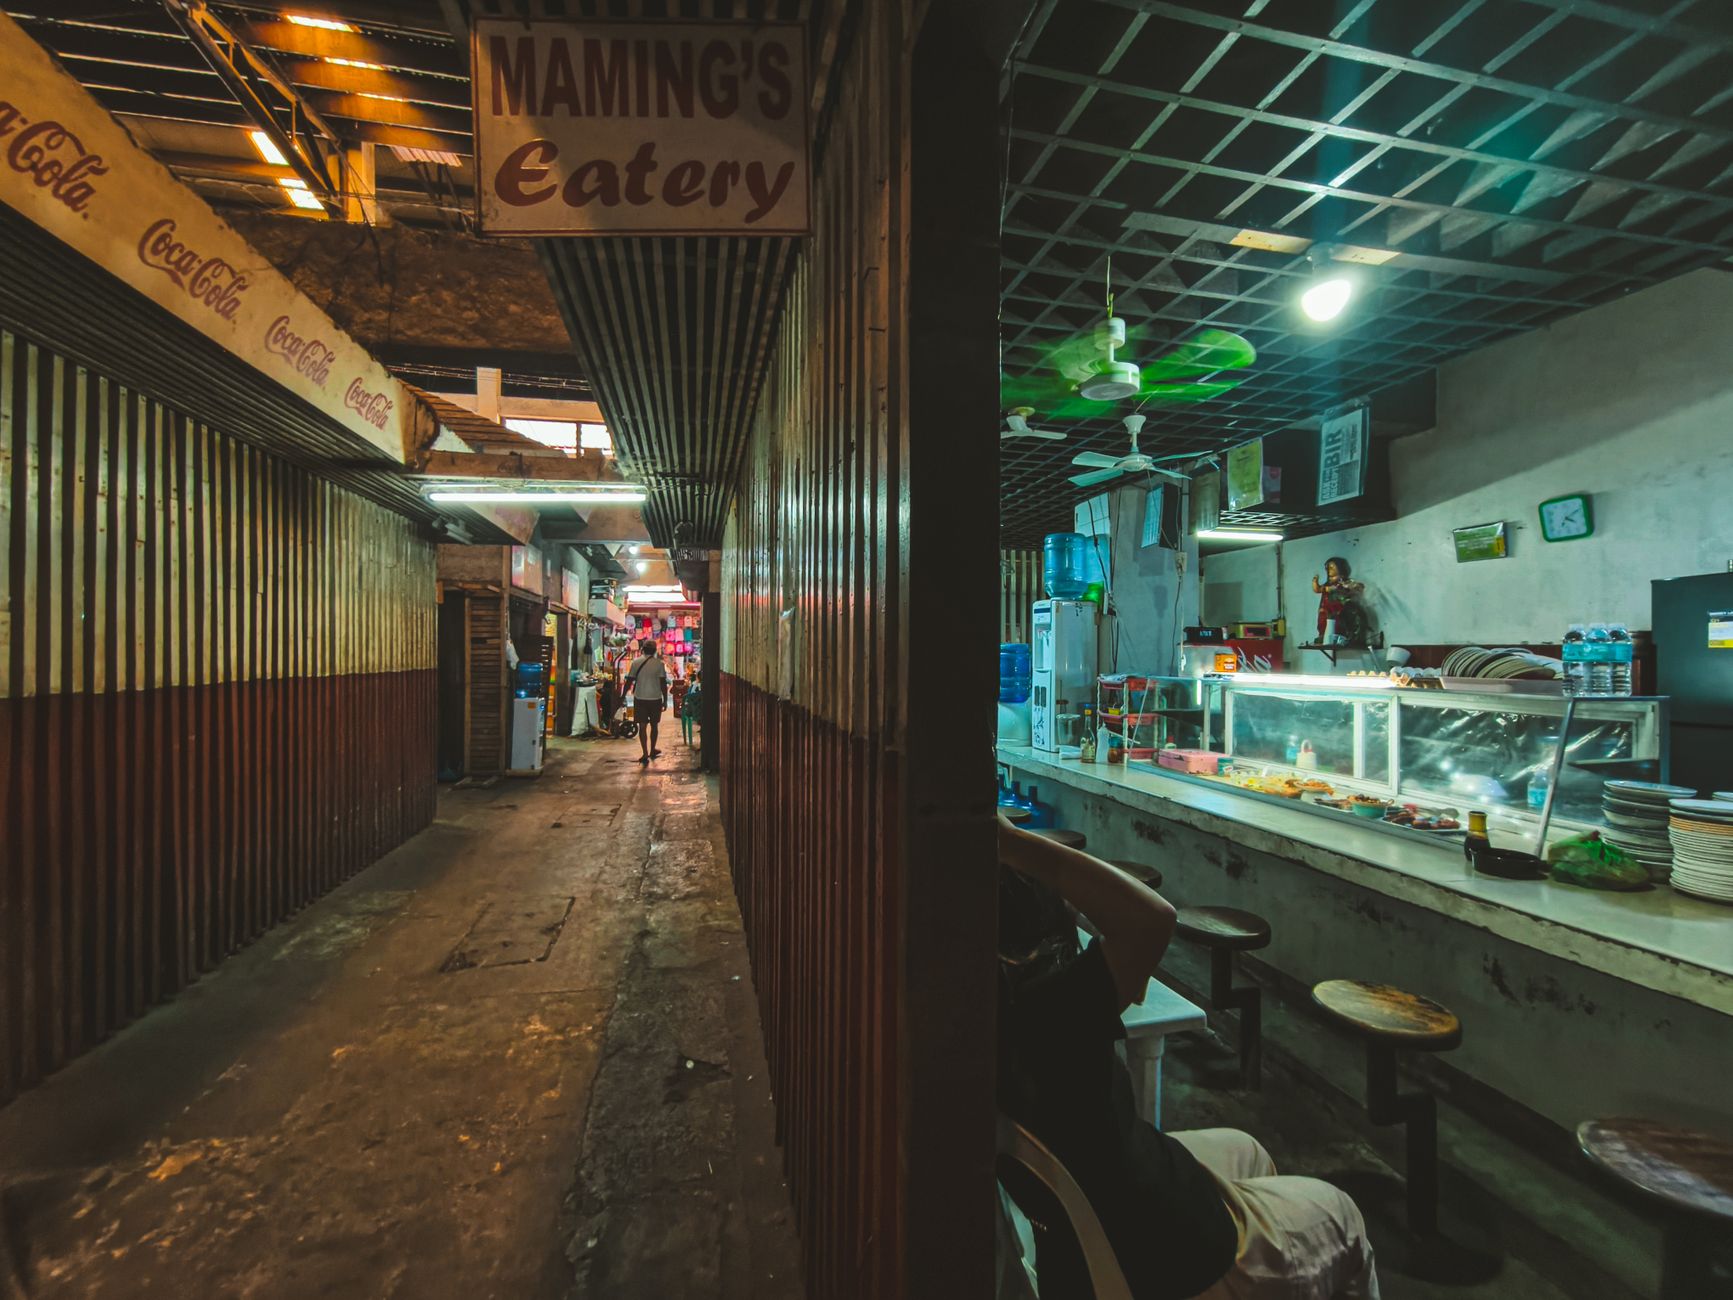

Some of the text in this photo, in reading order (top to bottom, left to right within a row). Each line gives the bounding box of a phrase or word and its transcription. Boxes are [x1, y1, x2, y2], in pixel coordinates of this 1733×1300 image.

[489, 35, 793, 121] MAMING'S
[493, 138, 796, 225] Eatery
[137, 218, 249, 321] Coca-Cola
[264, 315, 336, 387] Coca-Cola
[344, 376, 394, 431] Coca-Cola
[1325, 429, 1342, 467] BIR
